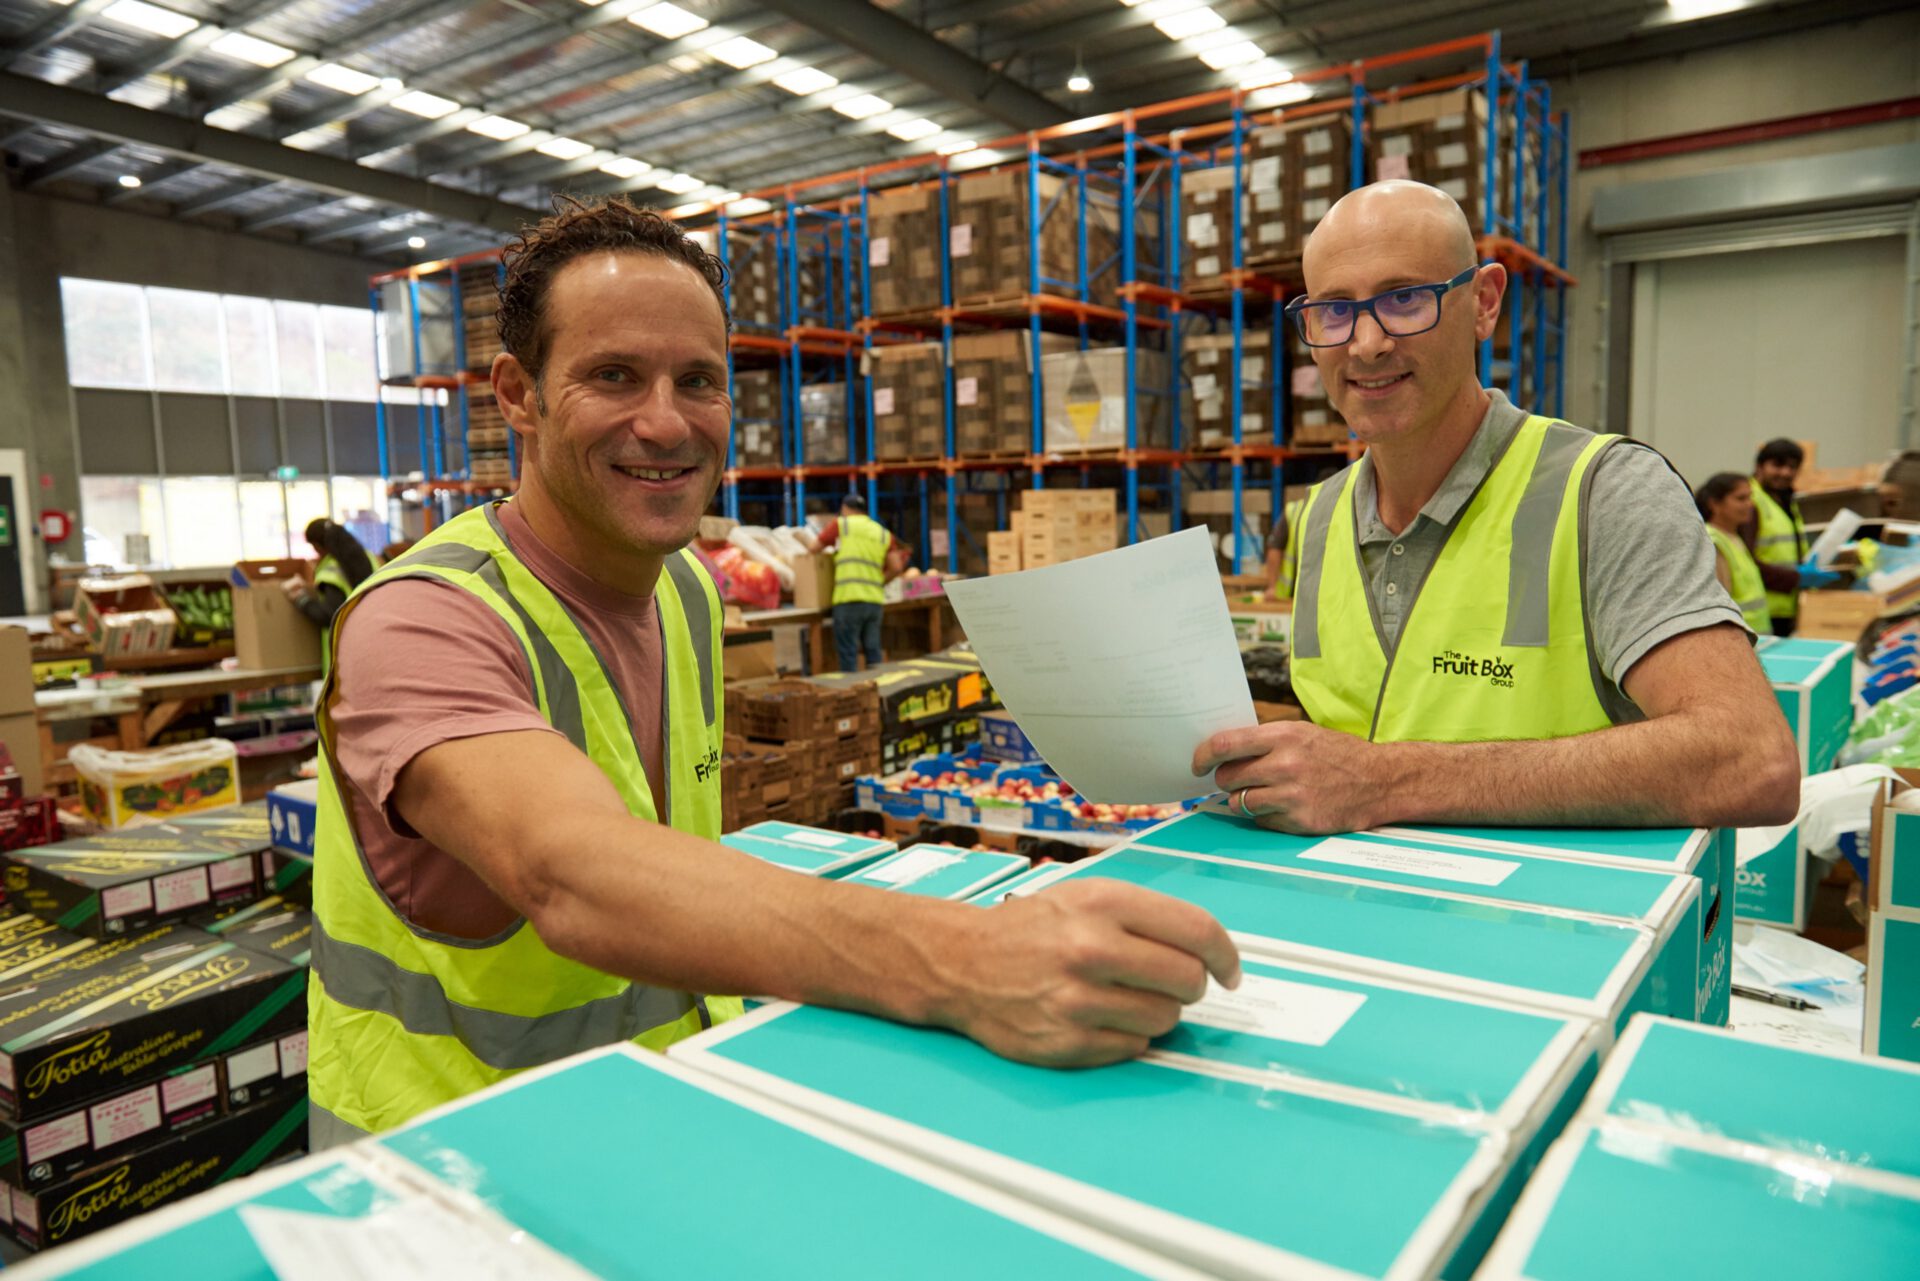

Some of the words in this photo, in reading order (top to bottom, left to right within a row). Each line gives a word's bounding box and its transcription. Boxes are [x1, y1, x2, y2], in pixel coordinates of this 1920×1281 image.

[1444, 650, 1461, 660] The
[1433, 656, 1478, 676] Fruit
[1481, 657, 1514, 679] Box
[1490, 678, 1514, 688] Group
[1735, 870, 1767, 888] ox
[24, 1030, 111, 1099] Fotia
[48, 1164, 131, 1240] Fotia
